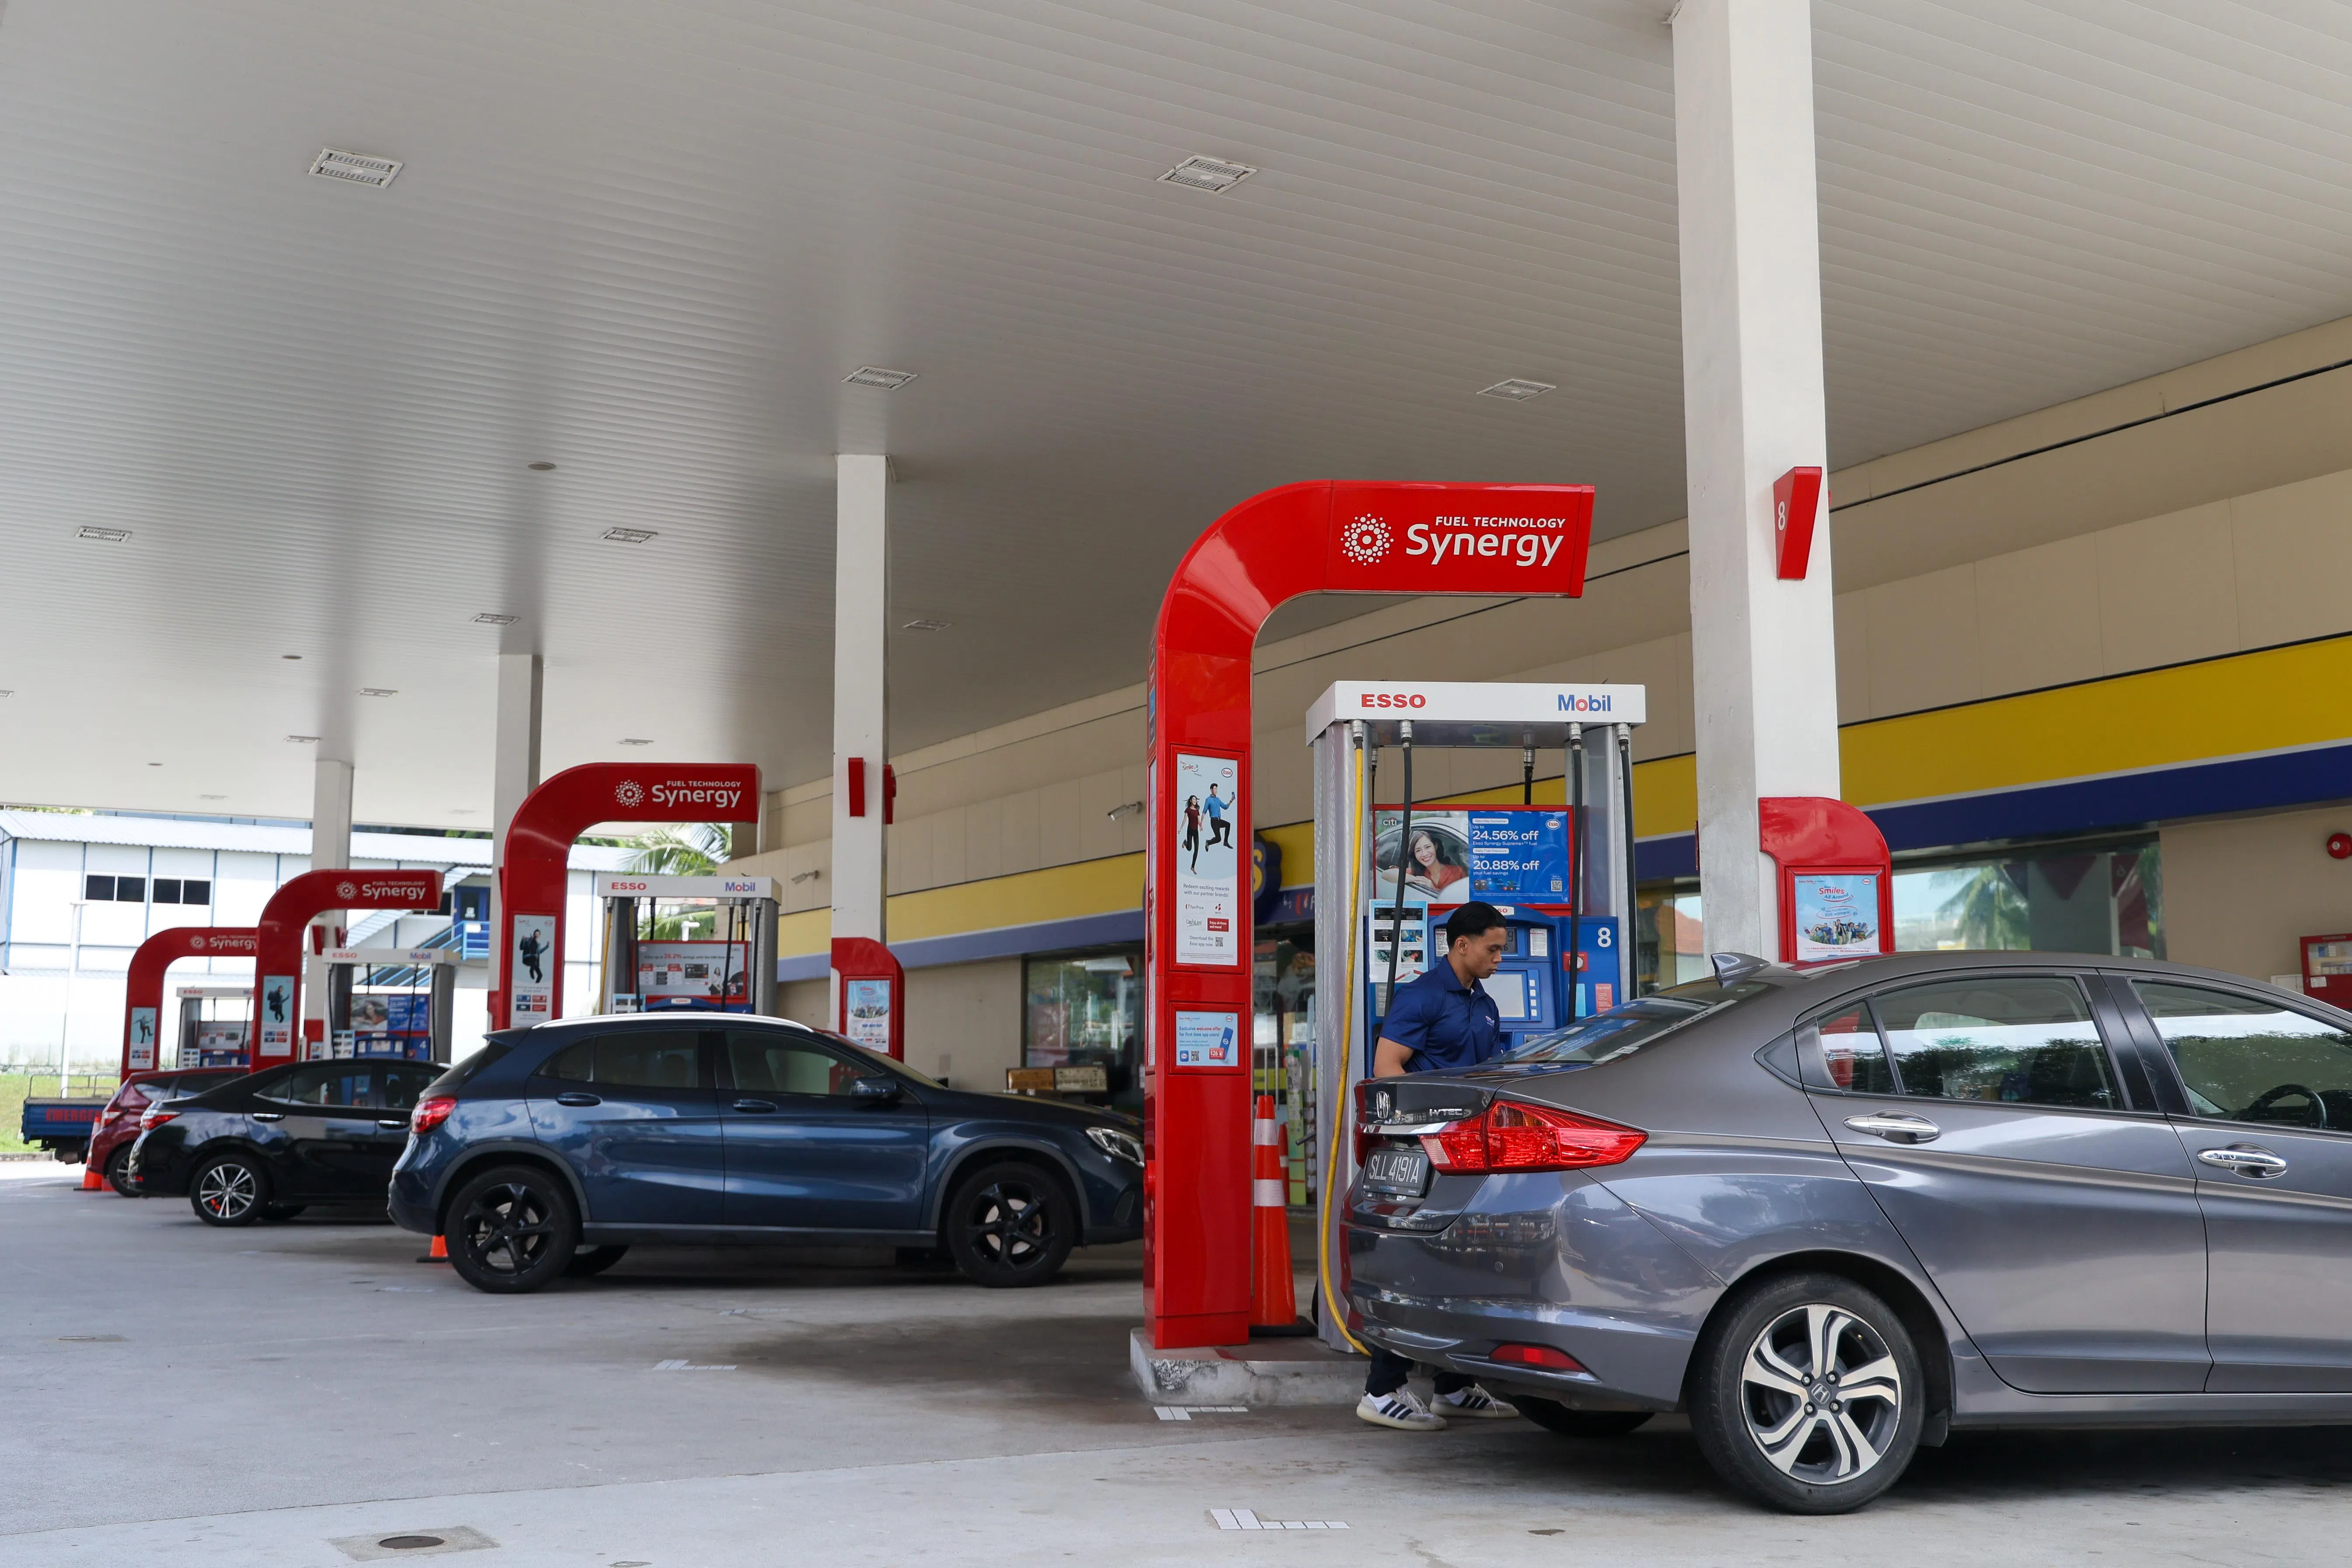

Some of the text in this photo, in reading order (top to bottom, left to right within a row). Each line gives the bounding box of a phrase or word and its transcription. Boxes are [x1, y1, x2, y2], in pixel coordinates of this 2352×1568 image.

[1435, 516, 1566, 528] FUEL TECHNOLOGY
[1778, 501, 1786, 530] 8
[1405, 523, 1565, 566] Synergy
[1361, 693, 1426, 708] ESSO
[1558, 694, 1611, 712] Mobil
[652, 785, 742, 808] Synergy
[1473, 830, 1539, 840] 24.56% off
[1473, 860, 1540, 870] 20.88% off
[362, 883, 427, 901] Synergy
[611, 882, 647, 891] ESSO
[725, 882, 756, 892] Mobil
[1819, 886, 1845, 895] Smiles
[1597, 927, 1612, 948] 8
[419, 1040, 427, 1049] 4
[1369, 1154, 1421, 1184] SLL 4191A
